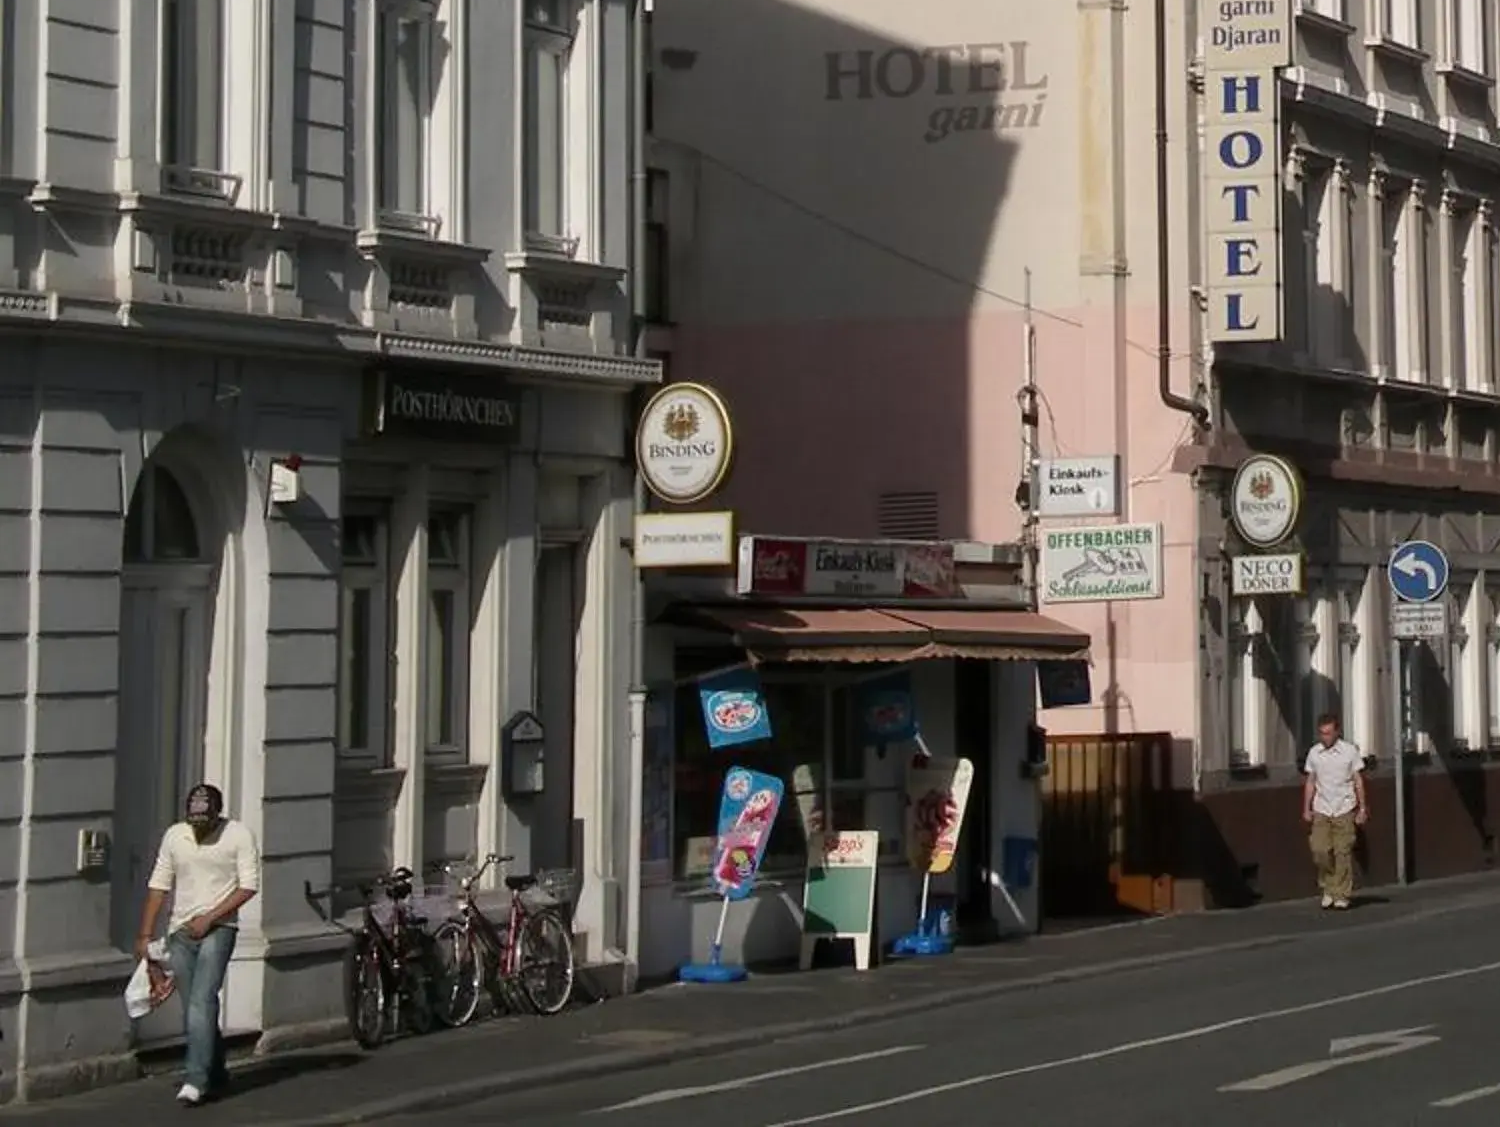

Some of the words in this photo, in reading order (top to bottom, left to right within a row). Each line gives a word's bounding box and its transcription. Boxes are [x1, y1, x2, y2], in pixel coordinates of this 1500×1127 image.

[1213, 26, 1281, 51] Djaran
[824, 41, 1048, 100] HOTEL
[923, 94, 1047, 144] garni
[1219, 76, 1263, 331] HOTEL
[649, 440, 715, 458] BINDING
[1050, 483, 1084, 495] Kiosk
[1047, 529, 1153, 550] OFFENBACHER
[1241, 558, 1293, 575] NECO
